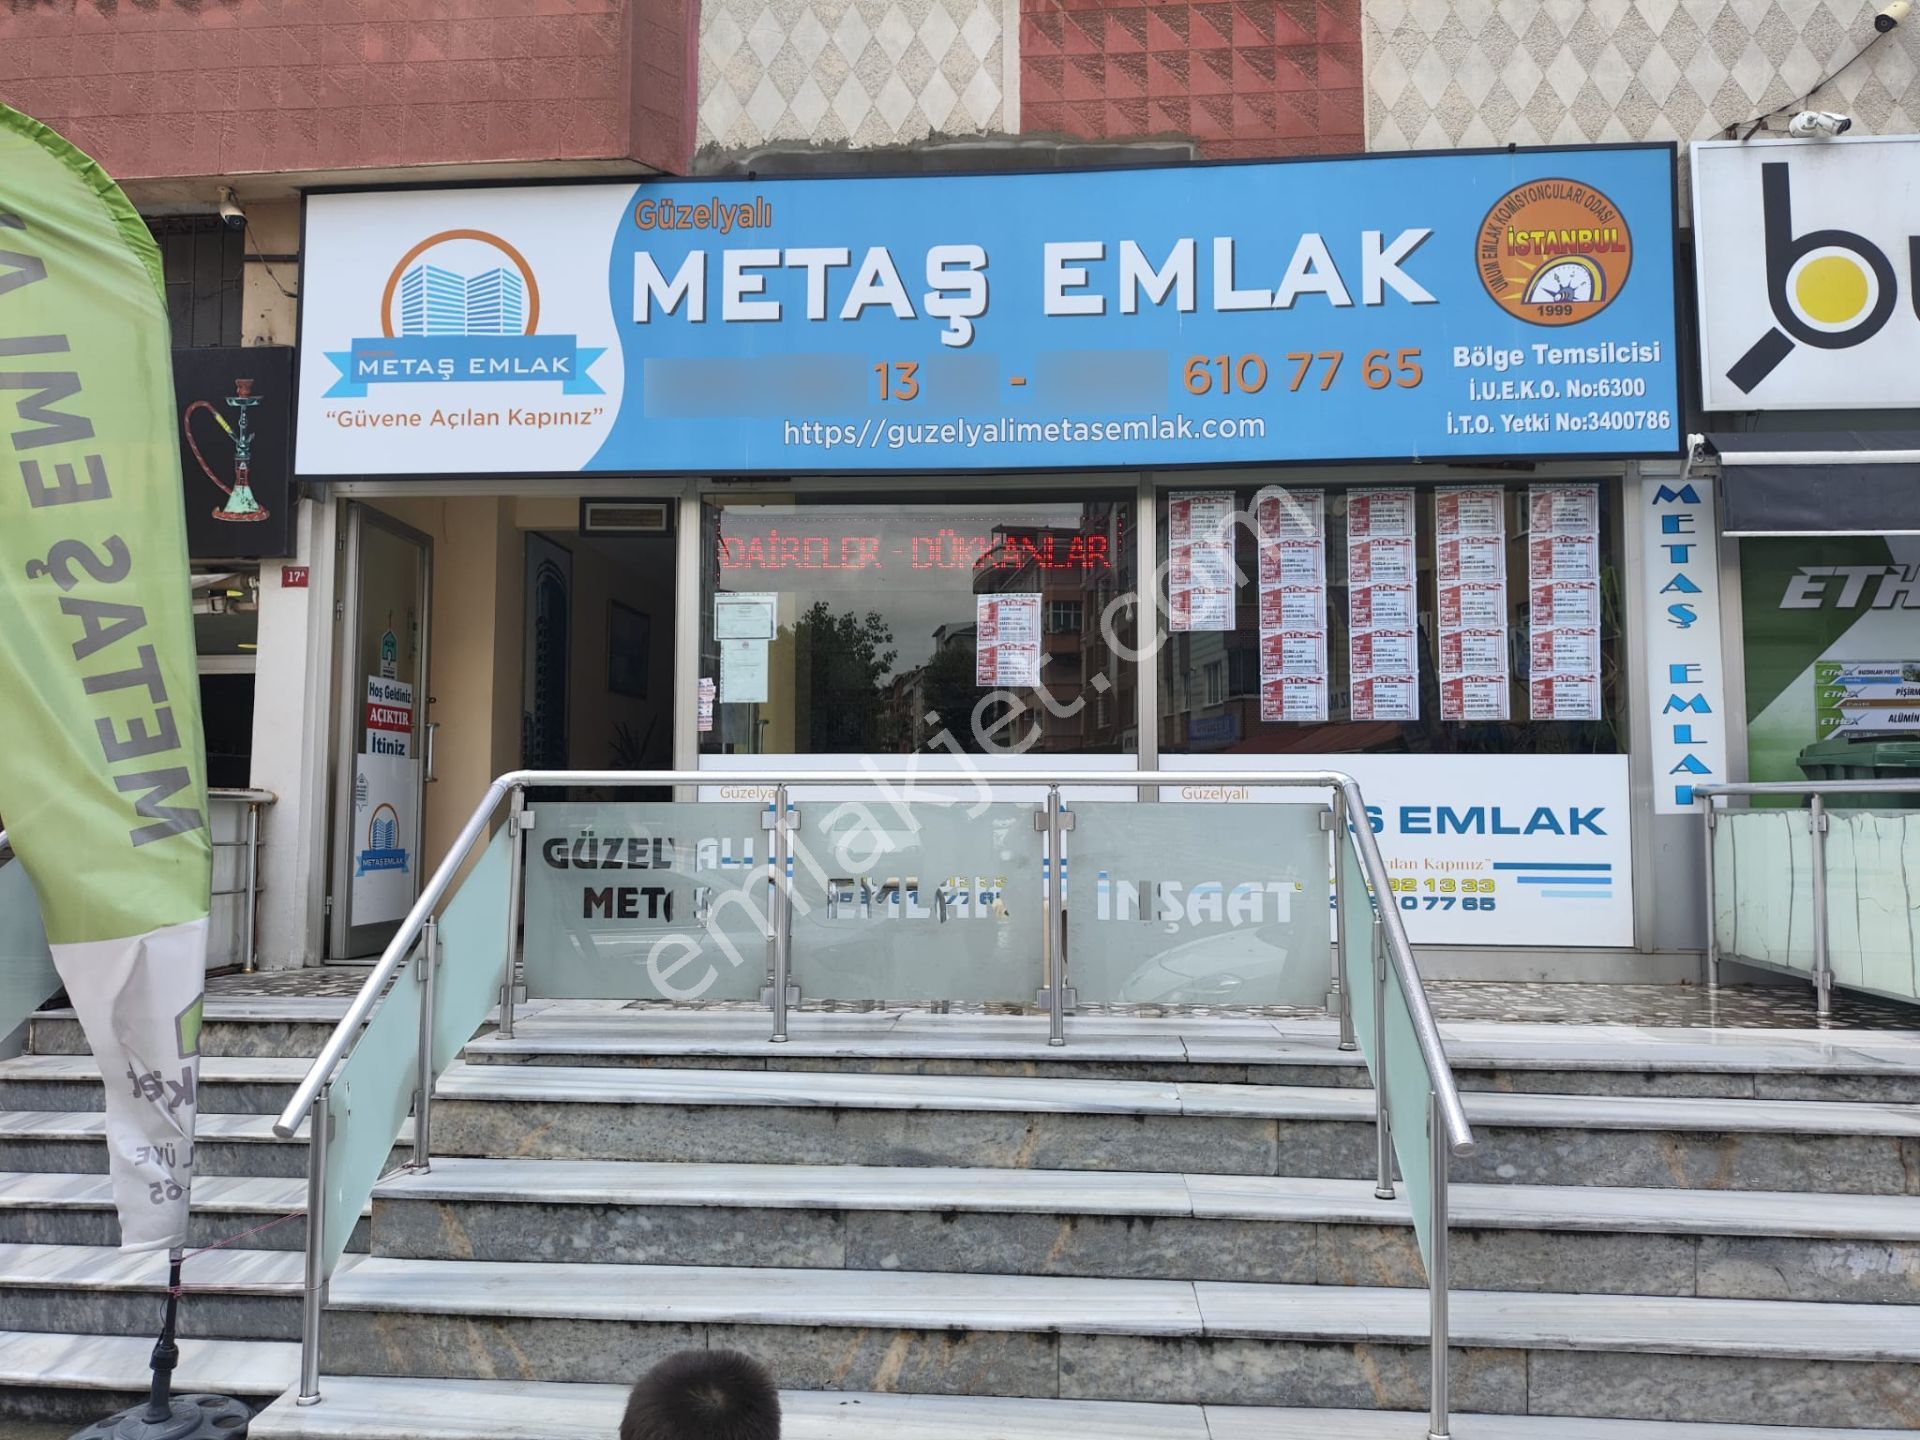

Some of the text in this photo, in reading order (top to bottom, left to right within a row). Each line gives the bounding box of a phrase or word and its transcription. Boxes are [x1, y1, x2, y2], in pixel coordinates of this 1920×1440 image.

[634, 196, 772, 234] Güzelyalı
[1482, 224, 1503, 259] EMLAK
[1584, 194, 1615, 224] ODASI
[1507, 226, 1625, 256] İSTANBUL
[633, 228, 1440, 347] METAŞ EMLAK
[1537, 304, 1573, 317] 1999
[358, 357, 571, 381] METAŞ EMLAK
[1453, 341, 1661, 371] Bölge Temsilcisi
[873, 361, 919, 401] 13
[1183, 353, 1268, 396] 610
[1286, 351, 1344, 392] 77
[1361, 348, 1423, 390] 65
[1469, 378, 1646, 401] İ.U.E.K.O. No:6300
[430, 408, 499, 429] Açılan
[784, 414, 1266, 449] https//guzelyalimetasemlak.com
[1447, 410, 1671, 434] İ.T.O. Yetki No:3400786
[720, 529, 883, 569] DAİRELER
[911, 528, 1112, 569] DÜKKANLAR
[1652, 483, 1703, 629] METAŞ
[369, 682, 411, 704] Hoş Geldiniz
[370, 706, 409, 726] AÇIKTIR
[371, 732, 405, 756] İtiniz
[1181, 786, 1249, 803] Güzelyalı
[1400, 805, 1608, 836] EMLAK
[1423, 878, 1457, 893] 13
[1461, 878, 1496, 893] 33
[1097, 870, 1298, 935] İNŞAAT
[1422, 896, 1457, 911] 77
[1461, 897, 1496, 912] 65
